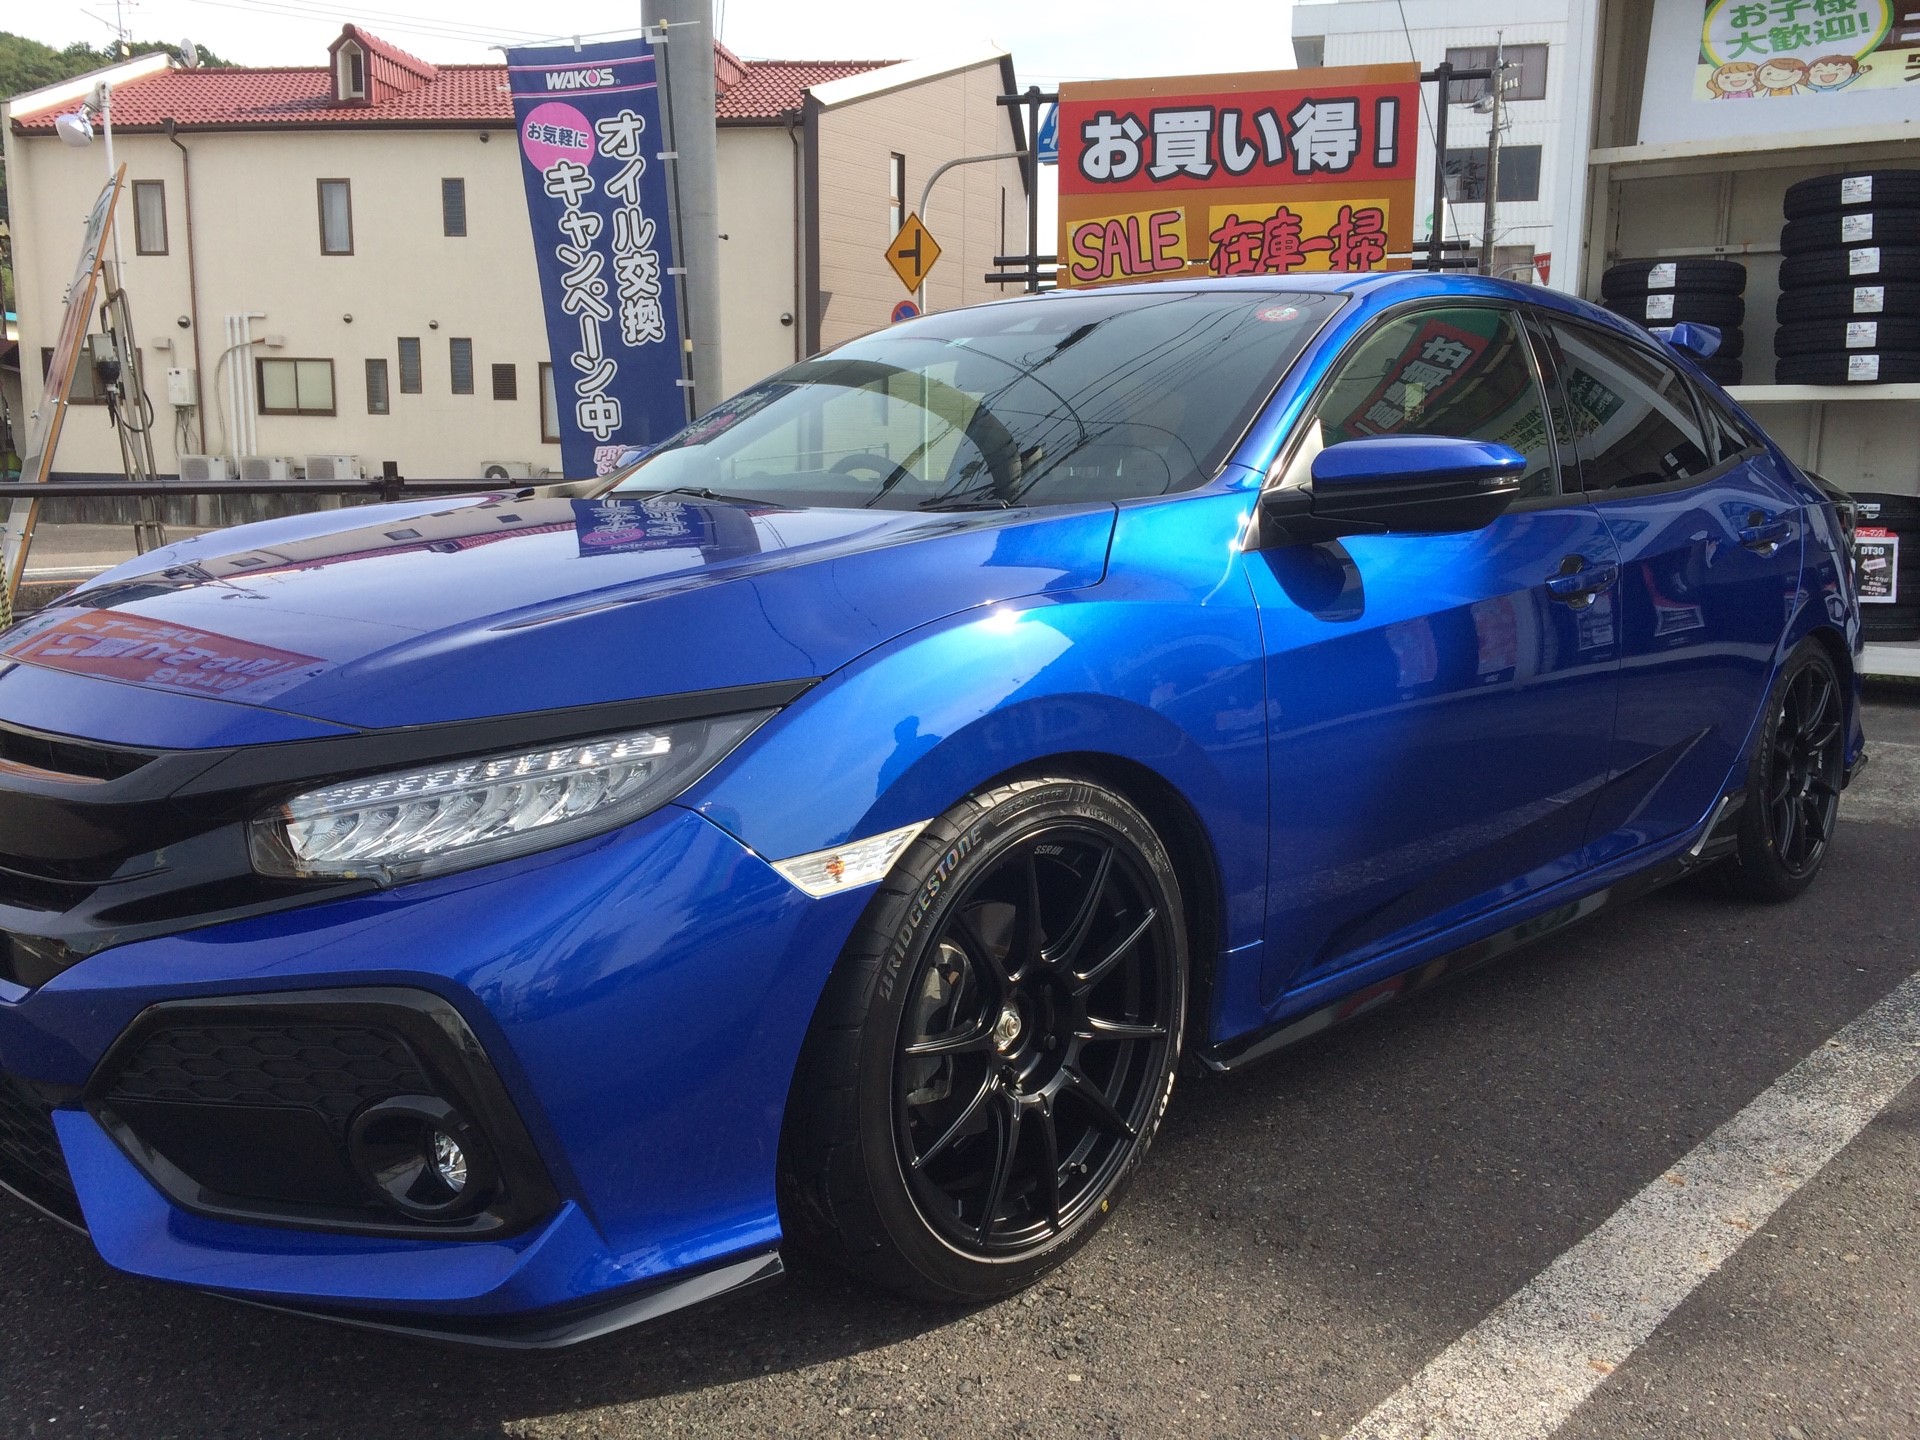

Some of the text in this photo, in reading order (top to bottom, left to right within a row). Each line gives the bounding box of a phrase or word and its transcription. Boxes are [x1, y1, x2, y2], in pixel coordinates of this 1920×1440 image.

[1726, 12, 1870, 59] 大歓迎!
[527, 122, 588, 148] お気軽に
[1081, 98, 1398, 182] お買い得!
[598, 109, 665, 345] オイル交換
[1072, 210, 1183, 281] SALE
[1210, 205, 1387, 272] 在庫一掃
[544, 160, 622, 441] キャンペーン中
[1861, 546, 1885, 555] DT30
[879, 824, 982, 1001] BRIDGESTONE
